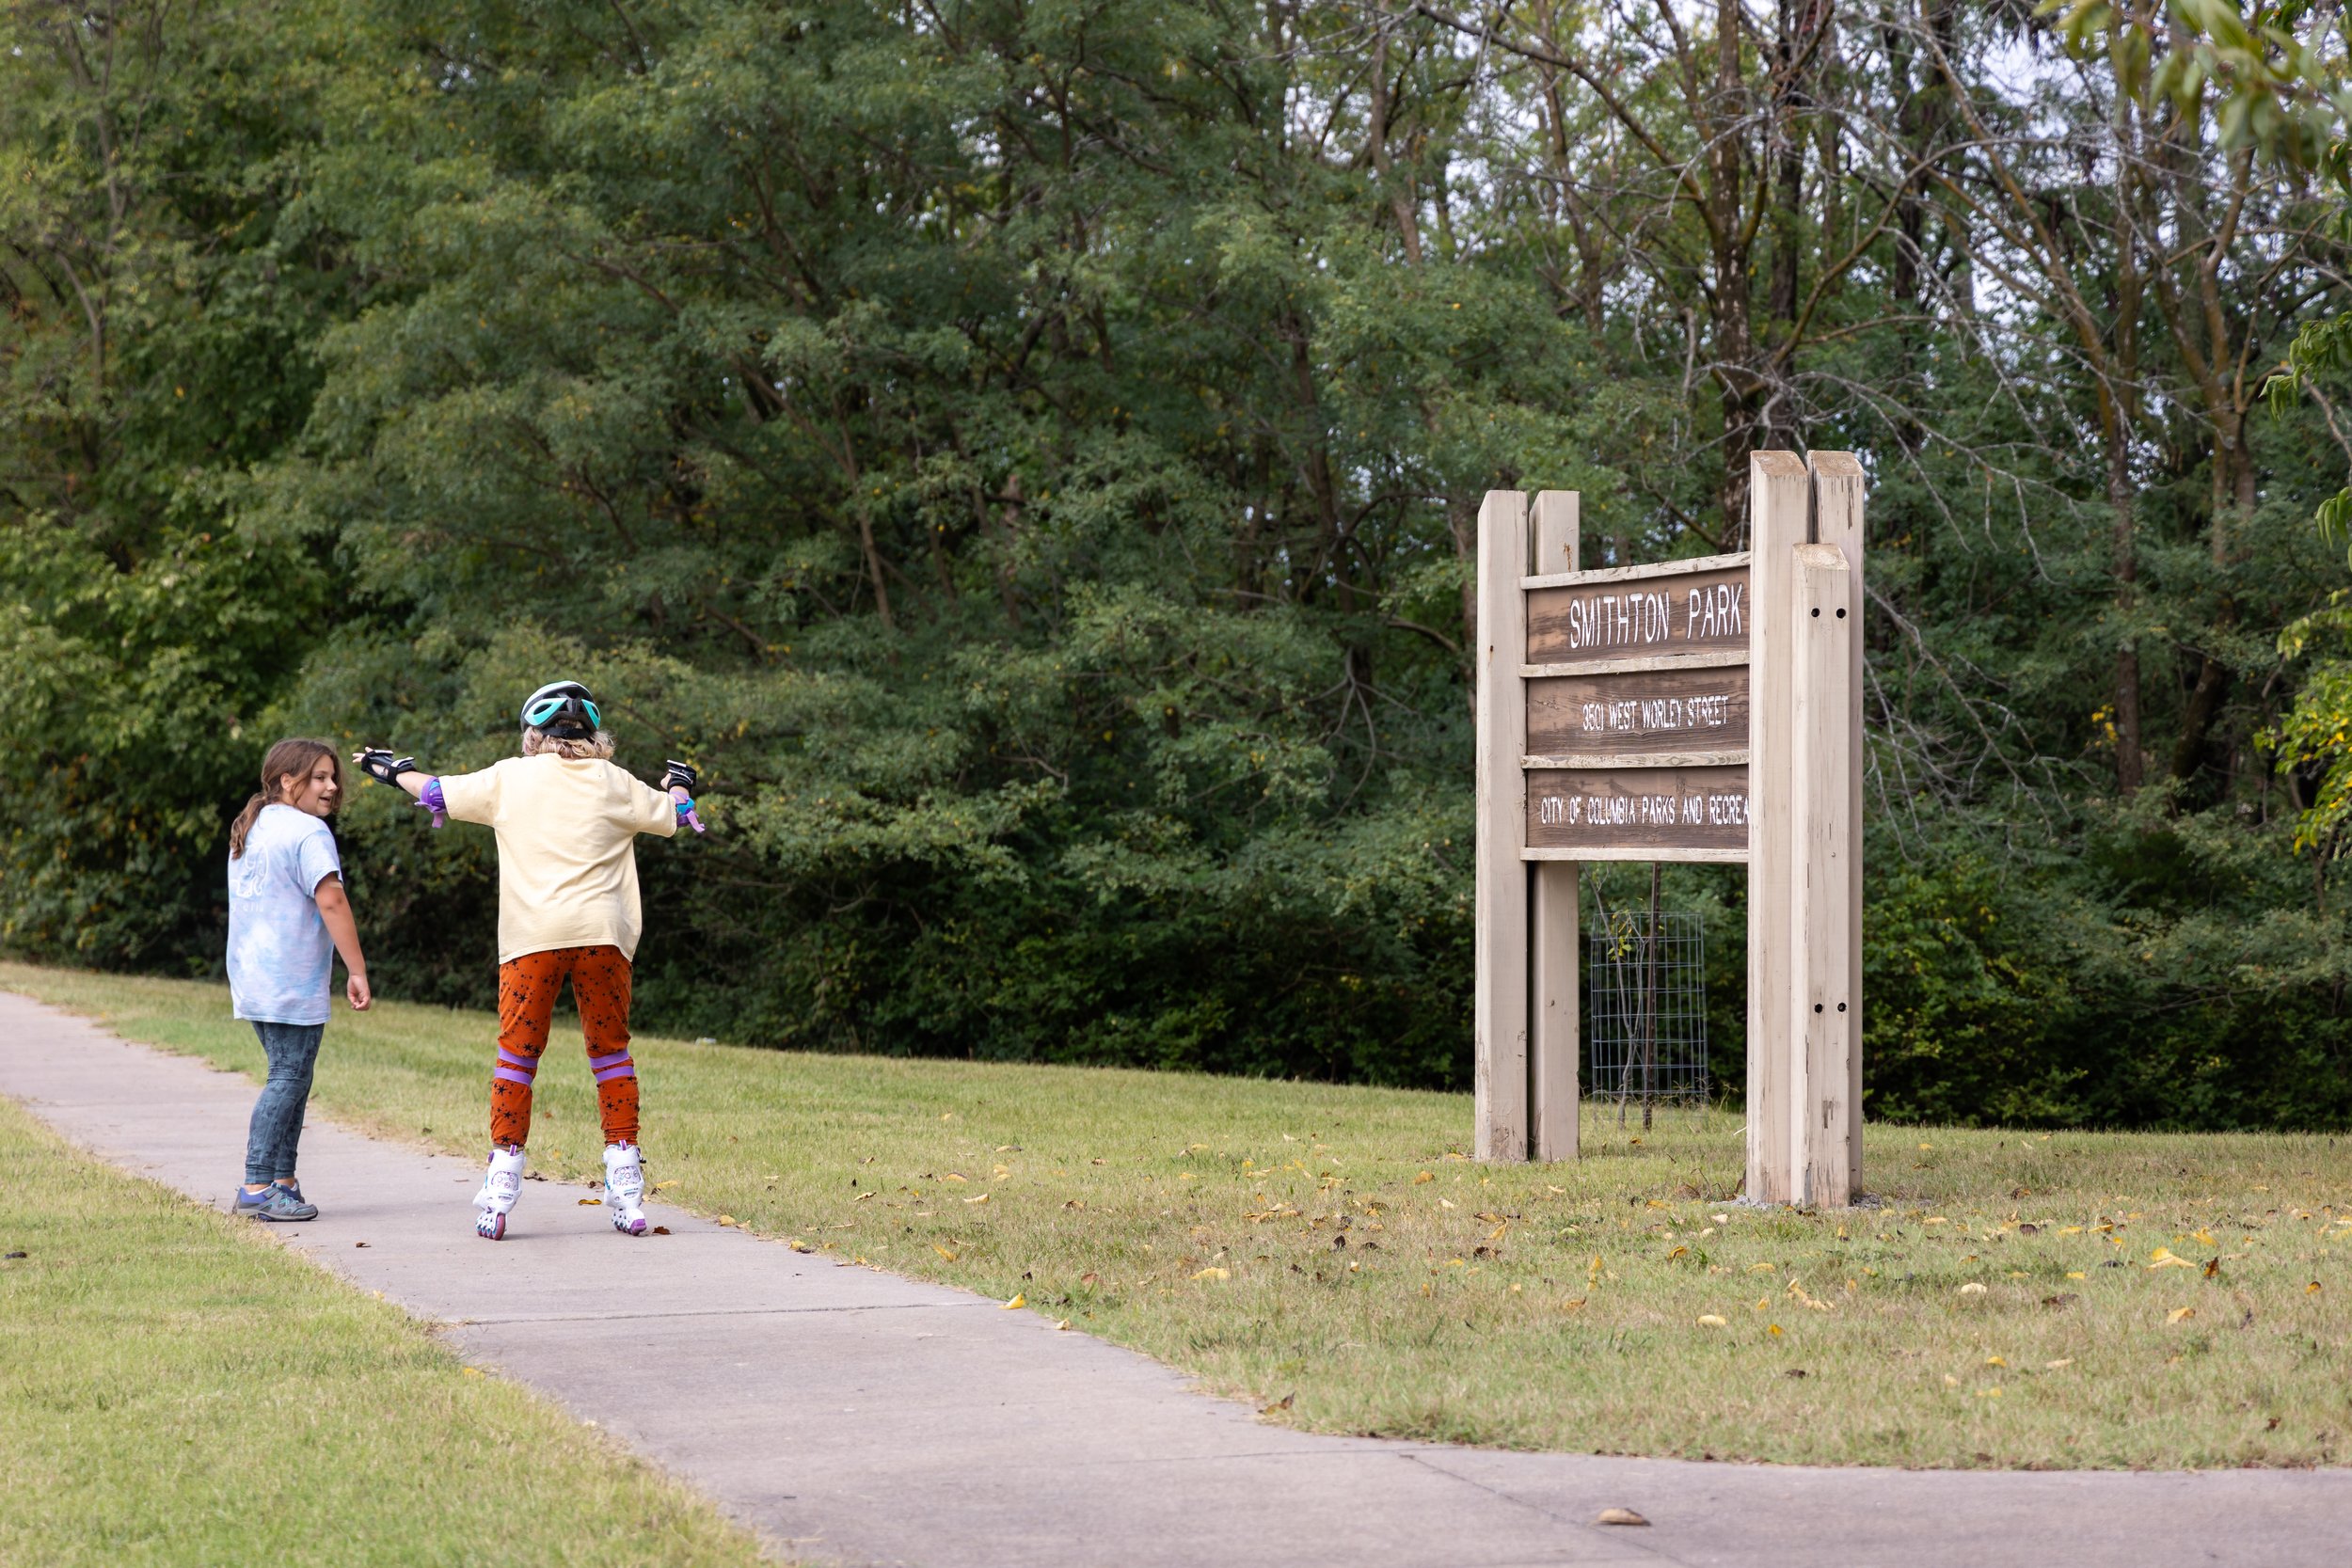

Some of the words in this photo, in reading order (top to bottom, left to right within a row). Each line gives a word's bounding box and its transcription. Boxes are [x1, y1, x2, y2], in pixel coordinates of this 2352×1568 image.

[1570, 592, 1670, 649] SMITHTON
[1687, 582, 1743, 639] PARK
[1582, 703, 1605, 731] 3501
[1608, 701, 1637, 730] WEST
[1642, 699, 1682, 729] WORLEY
[1687, 696, 1729, 727] STREET
[1541, 796, 1563, 824] CITY
[1568, 796, 1582, 824] OF
[1587, 796, 1636, 824] COLUMBIA
[1642, 795, 1676, 824] PARKS
[1681, 795, 1703, 824] AND
